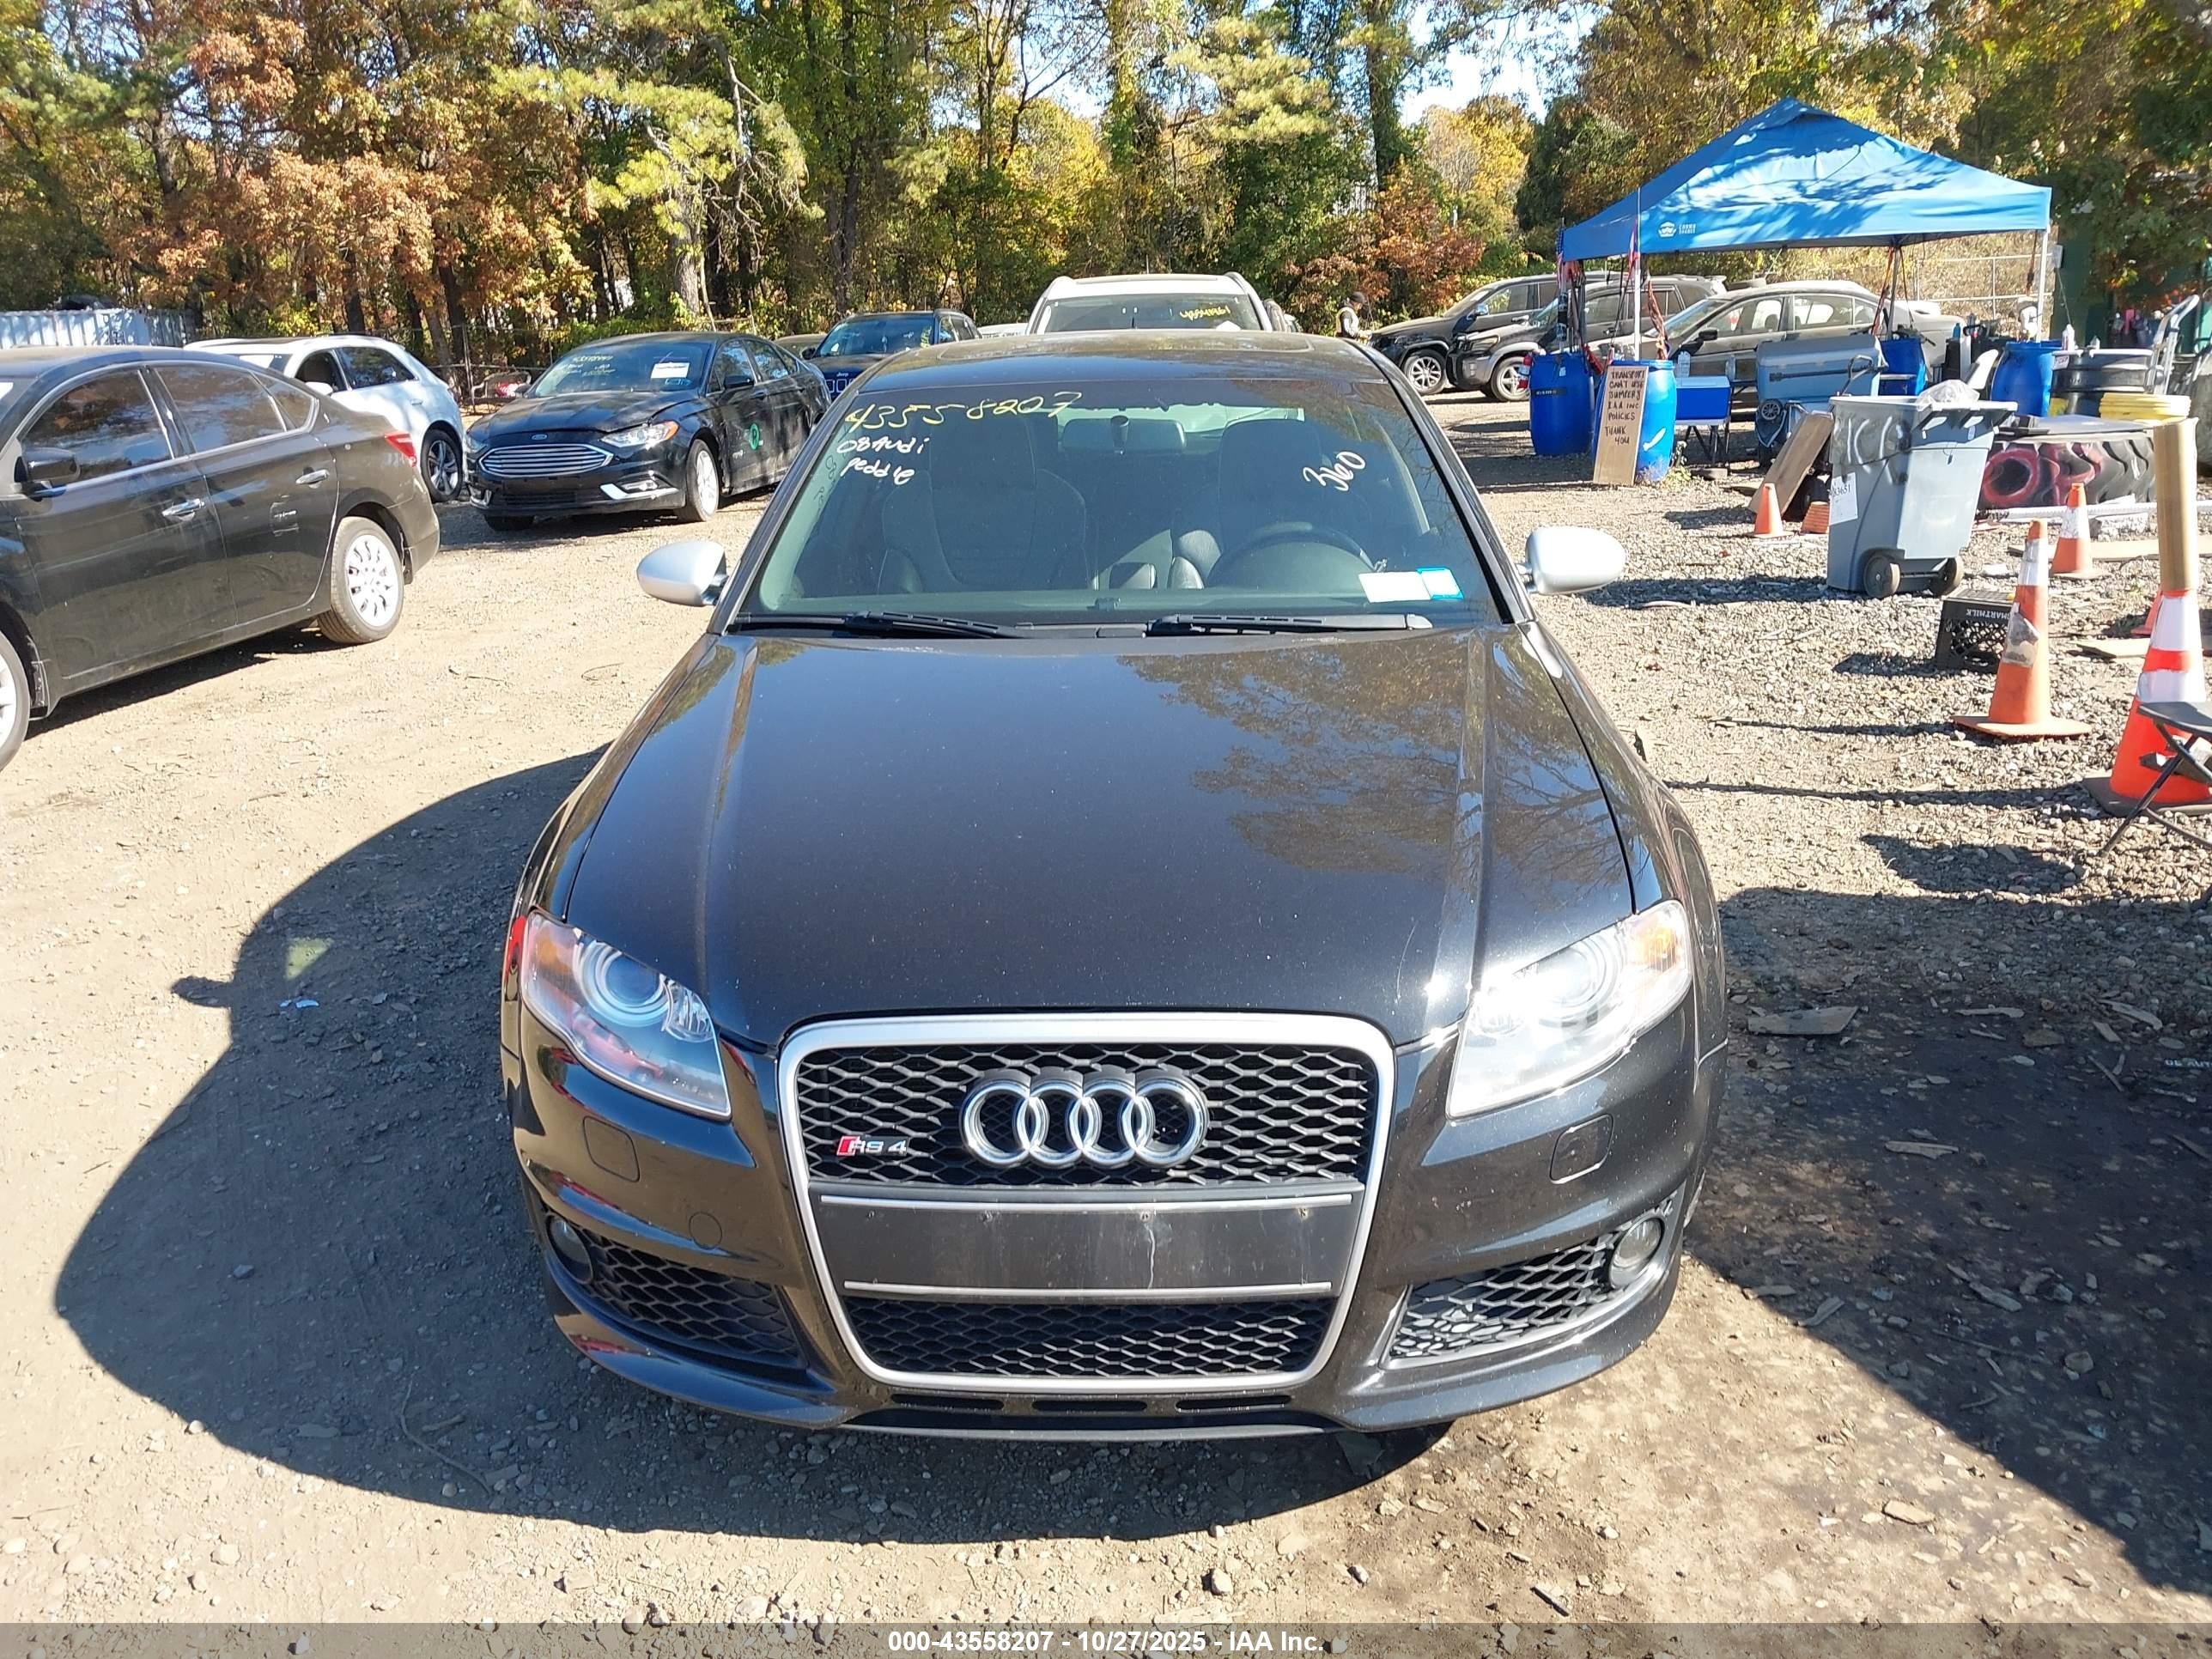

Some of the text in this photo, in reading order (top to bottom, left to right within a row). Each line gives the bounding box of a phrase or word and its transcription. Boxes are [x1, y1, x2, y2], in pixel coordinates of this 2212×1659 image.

[1611, 370, 1645, 380] TRANSPORT
[1631, 380, 1644, 390] USE
[1608, 390, 1641, 401] JUMPERS
[1607, 401, 1623, 410] IAA
[845, 392, 1082, 433] 43558207
[1604, 425, 1626, 437] THANK
[1614, 436, 1630, 446] YOU
